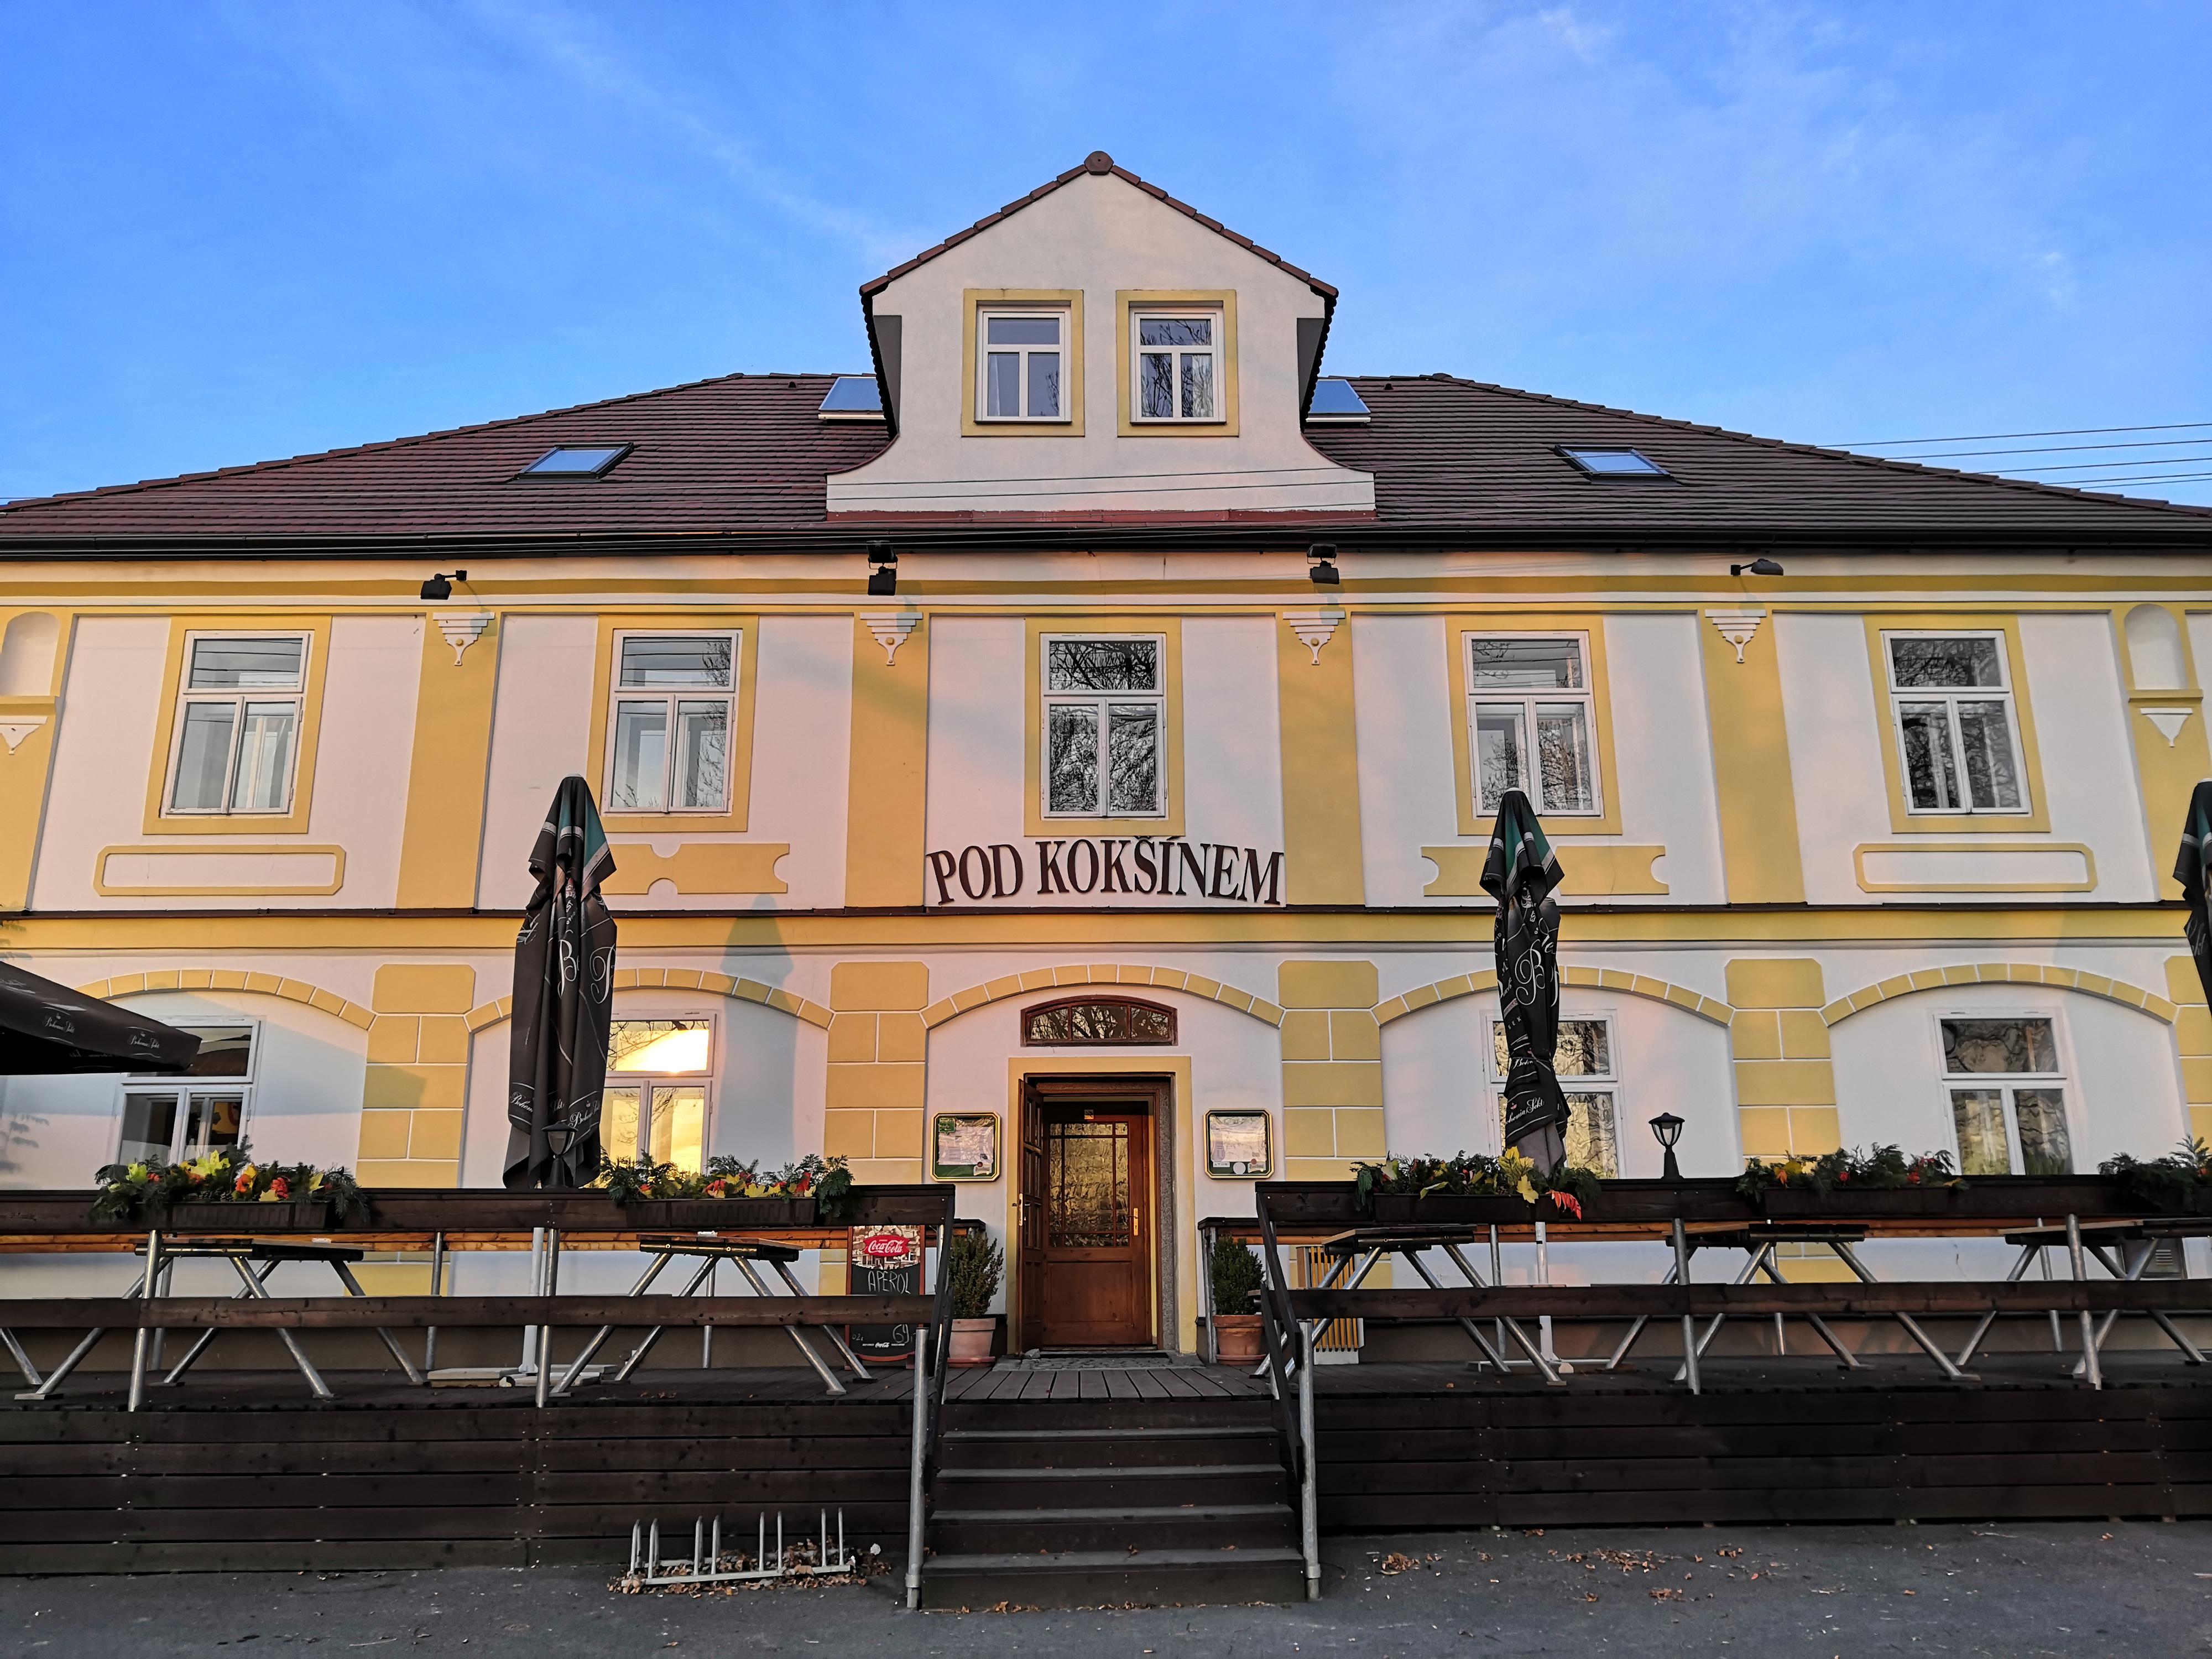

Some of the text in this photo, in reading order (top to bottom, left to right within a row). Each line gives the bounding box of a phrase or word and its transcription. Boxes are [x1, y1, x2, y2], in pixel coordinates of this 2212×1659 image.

[926, 835, 1285, 905] POD KOKŠÍNEM
[868, 1239, 905, 1254] Coca-Cola
[868, 1270, 911, 1295] APEROL
